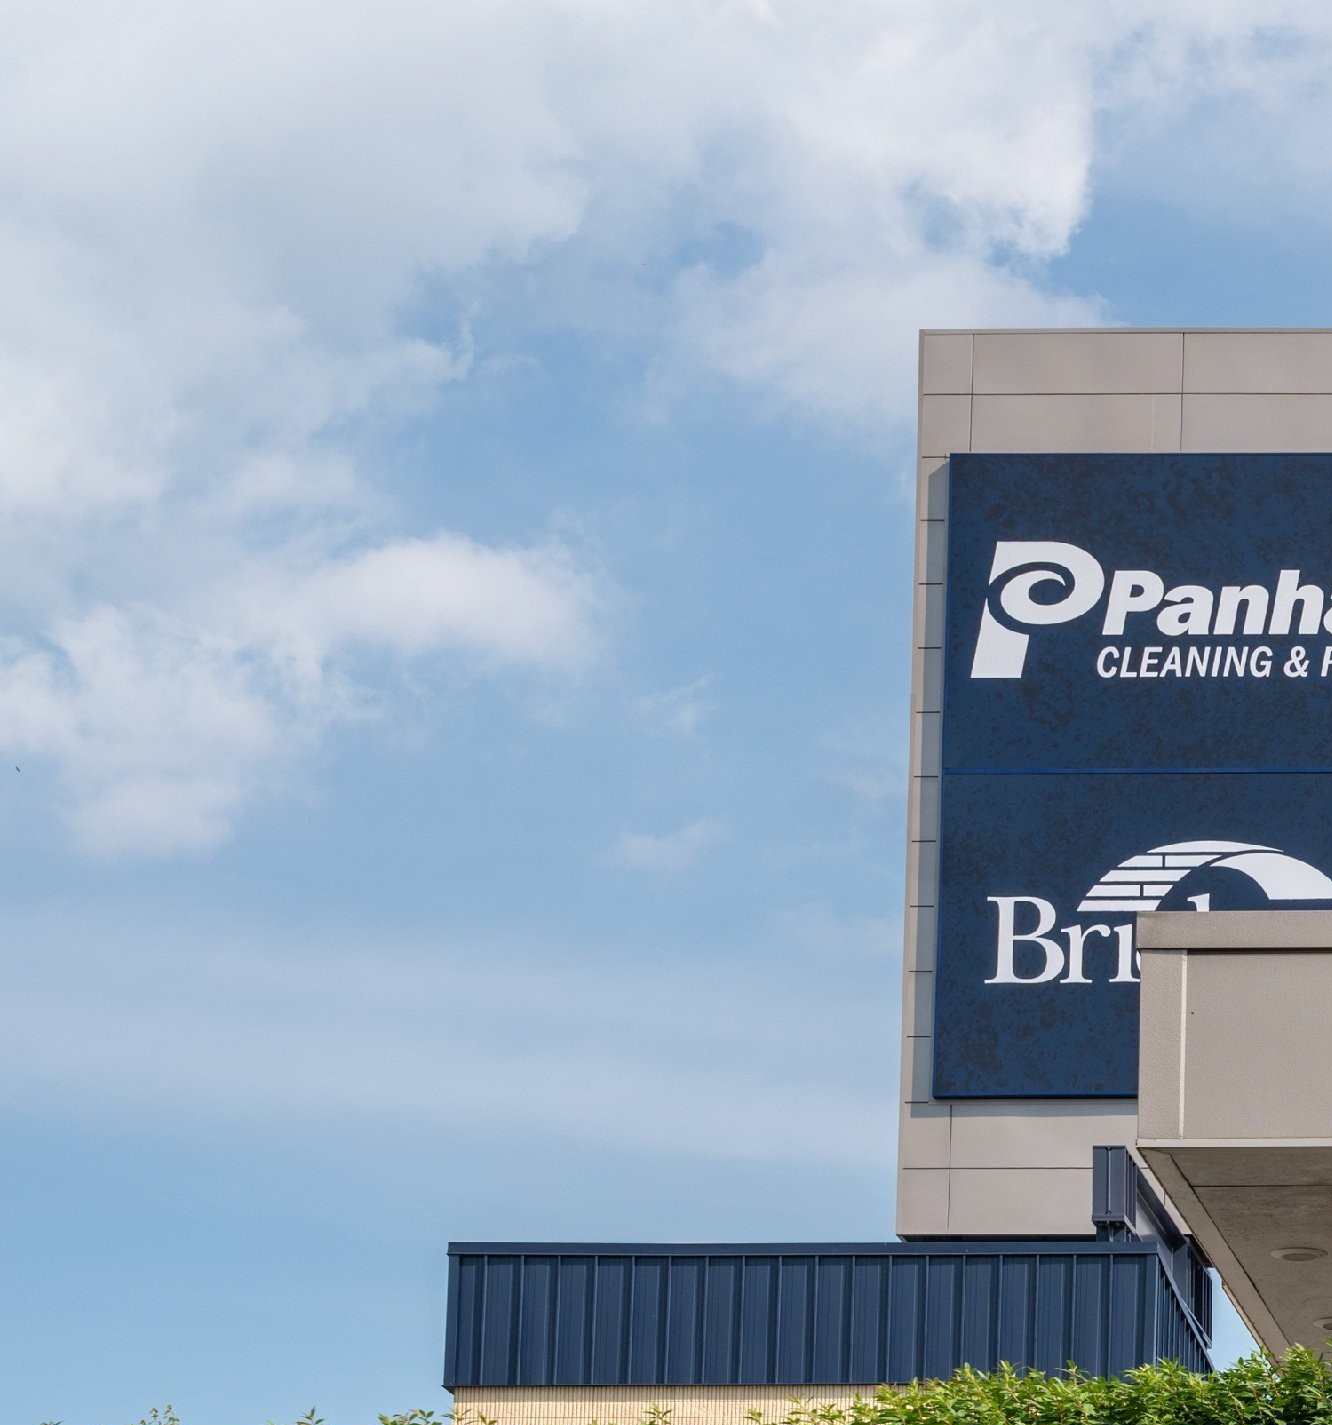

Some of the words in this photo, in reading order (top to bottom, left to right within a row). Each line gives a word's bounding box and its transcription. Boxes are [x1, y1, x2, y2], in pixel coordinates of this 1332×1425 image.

[1096, 646, 1273, 679] CLEANING
[1283, 645, 1310, 678] &
[984, 890, 1210, 985] Bri
